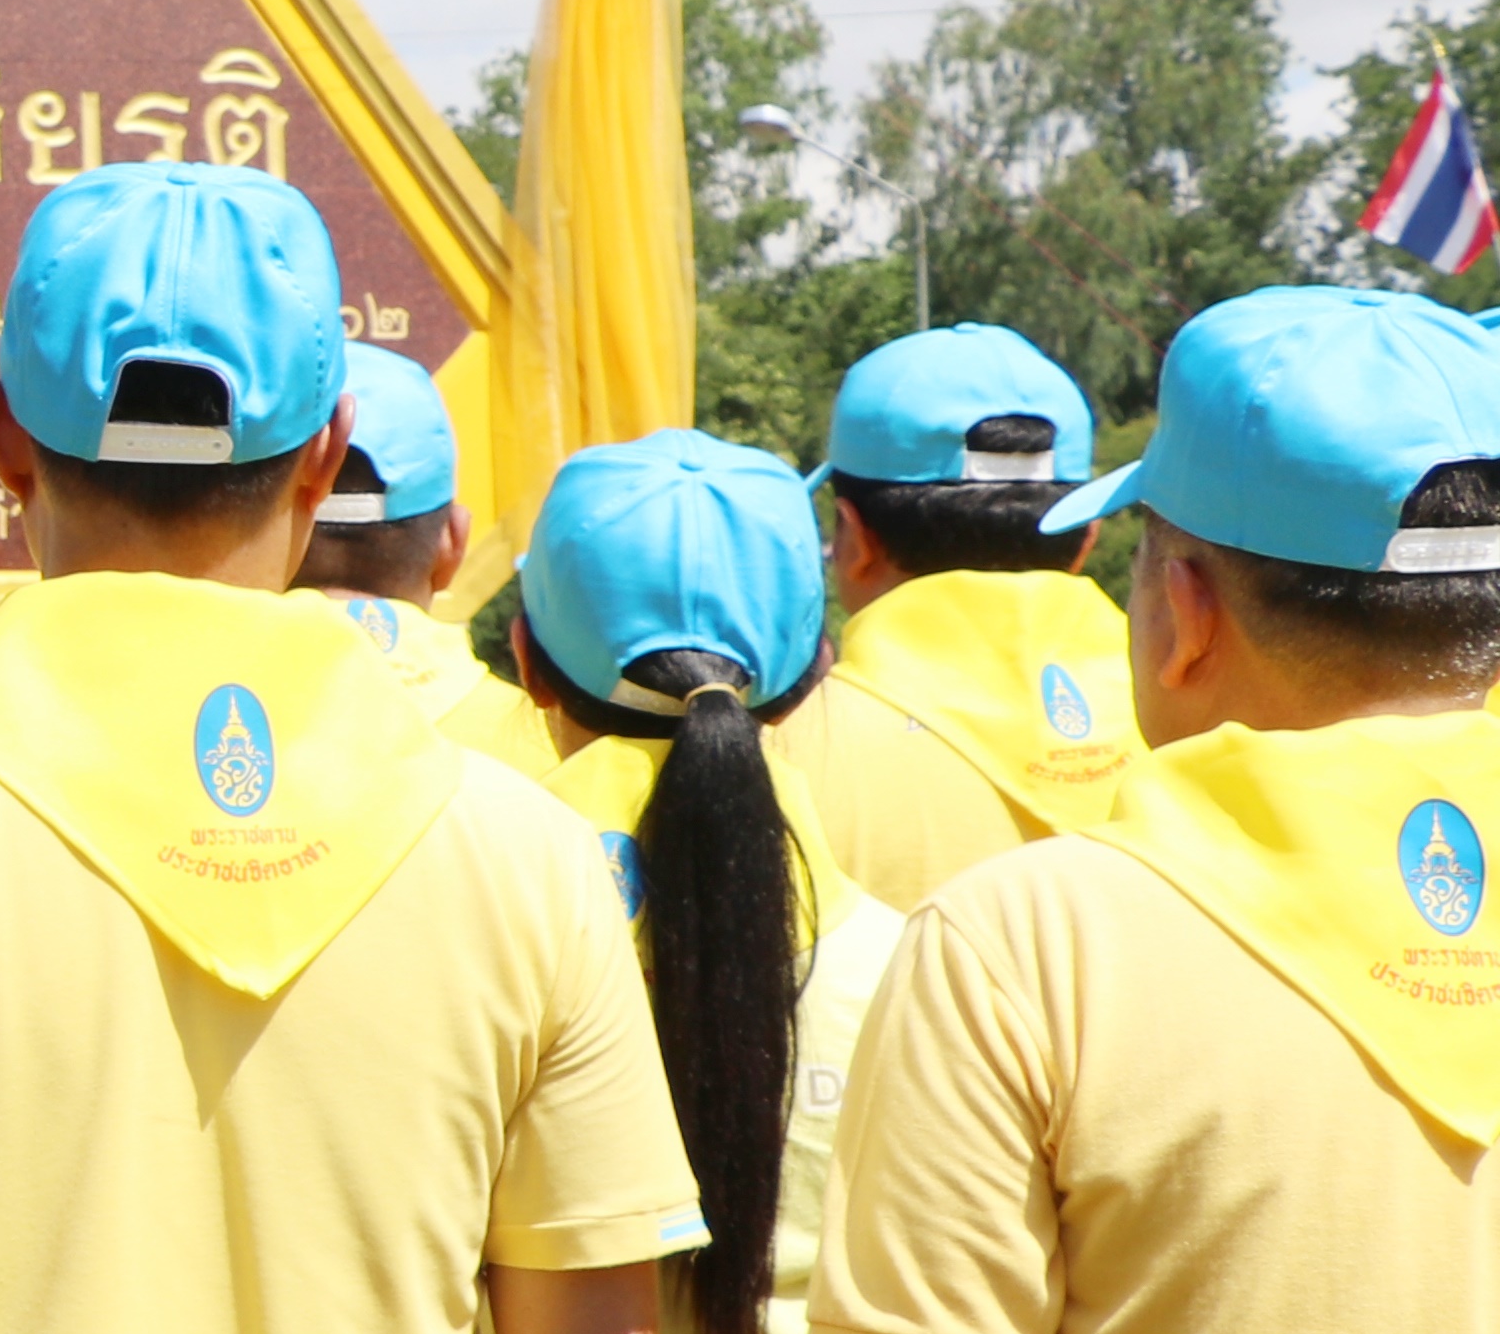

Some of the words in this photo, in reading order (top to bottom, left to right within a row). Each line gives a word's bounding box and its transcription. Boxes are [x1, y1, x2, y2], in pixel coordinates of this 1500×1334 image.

[192, 826, 297, 845] พระราชทาน
[157, 839, 332, 883] ประชาชนจิตอาสา
